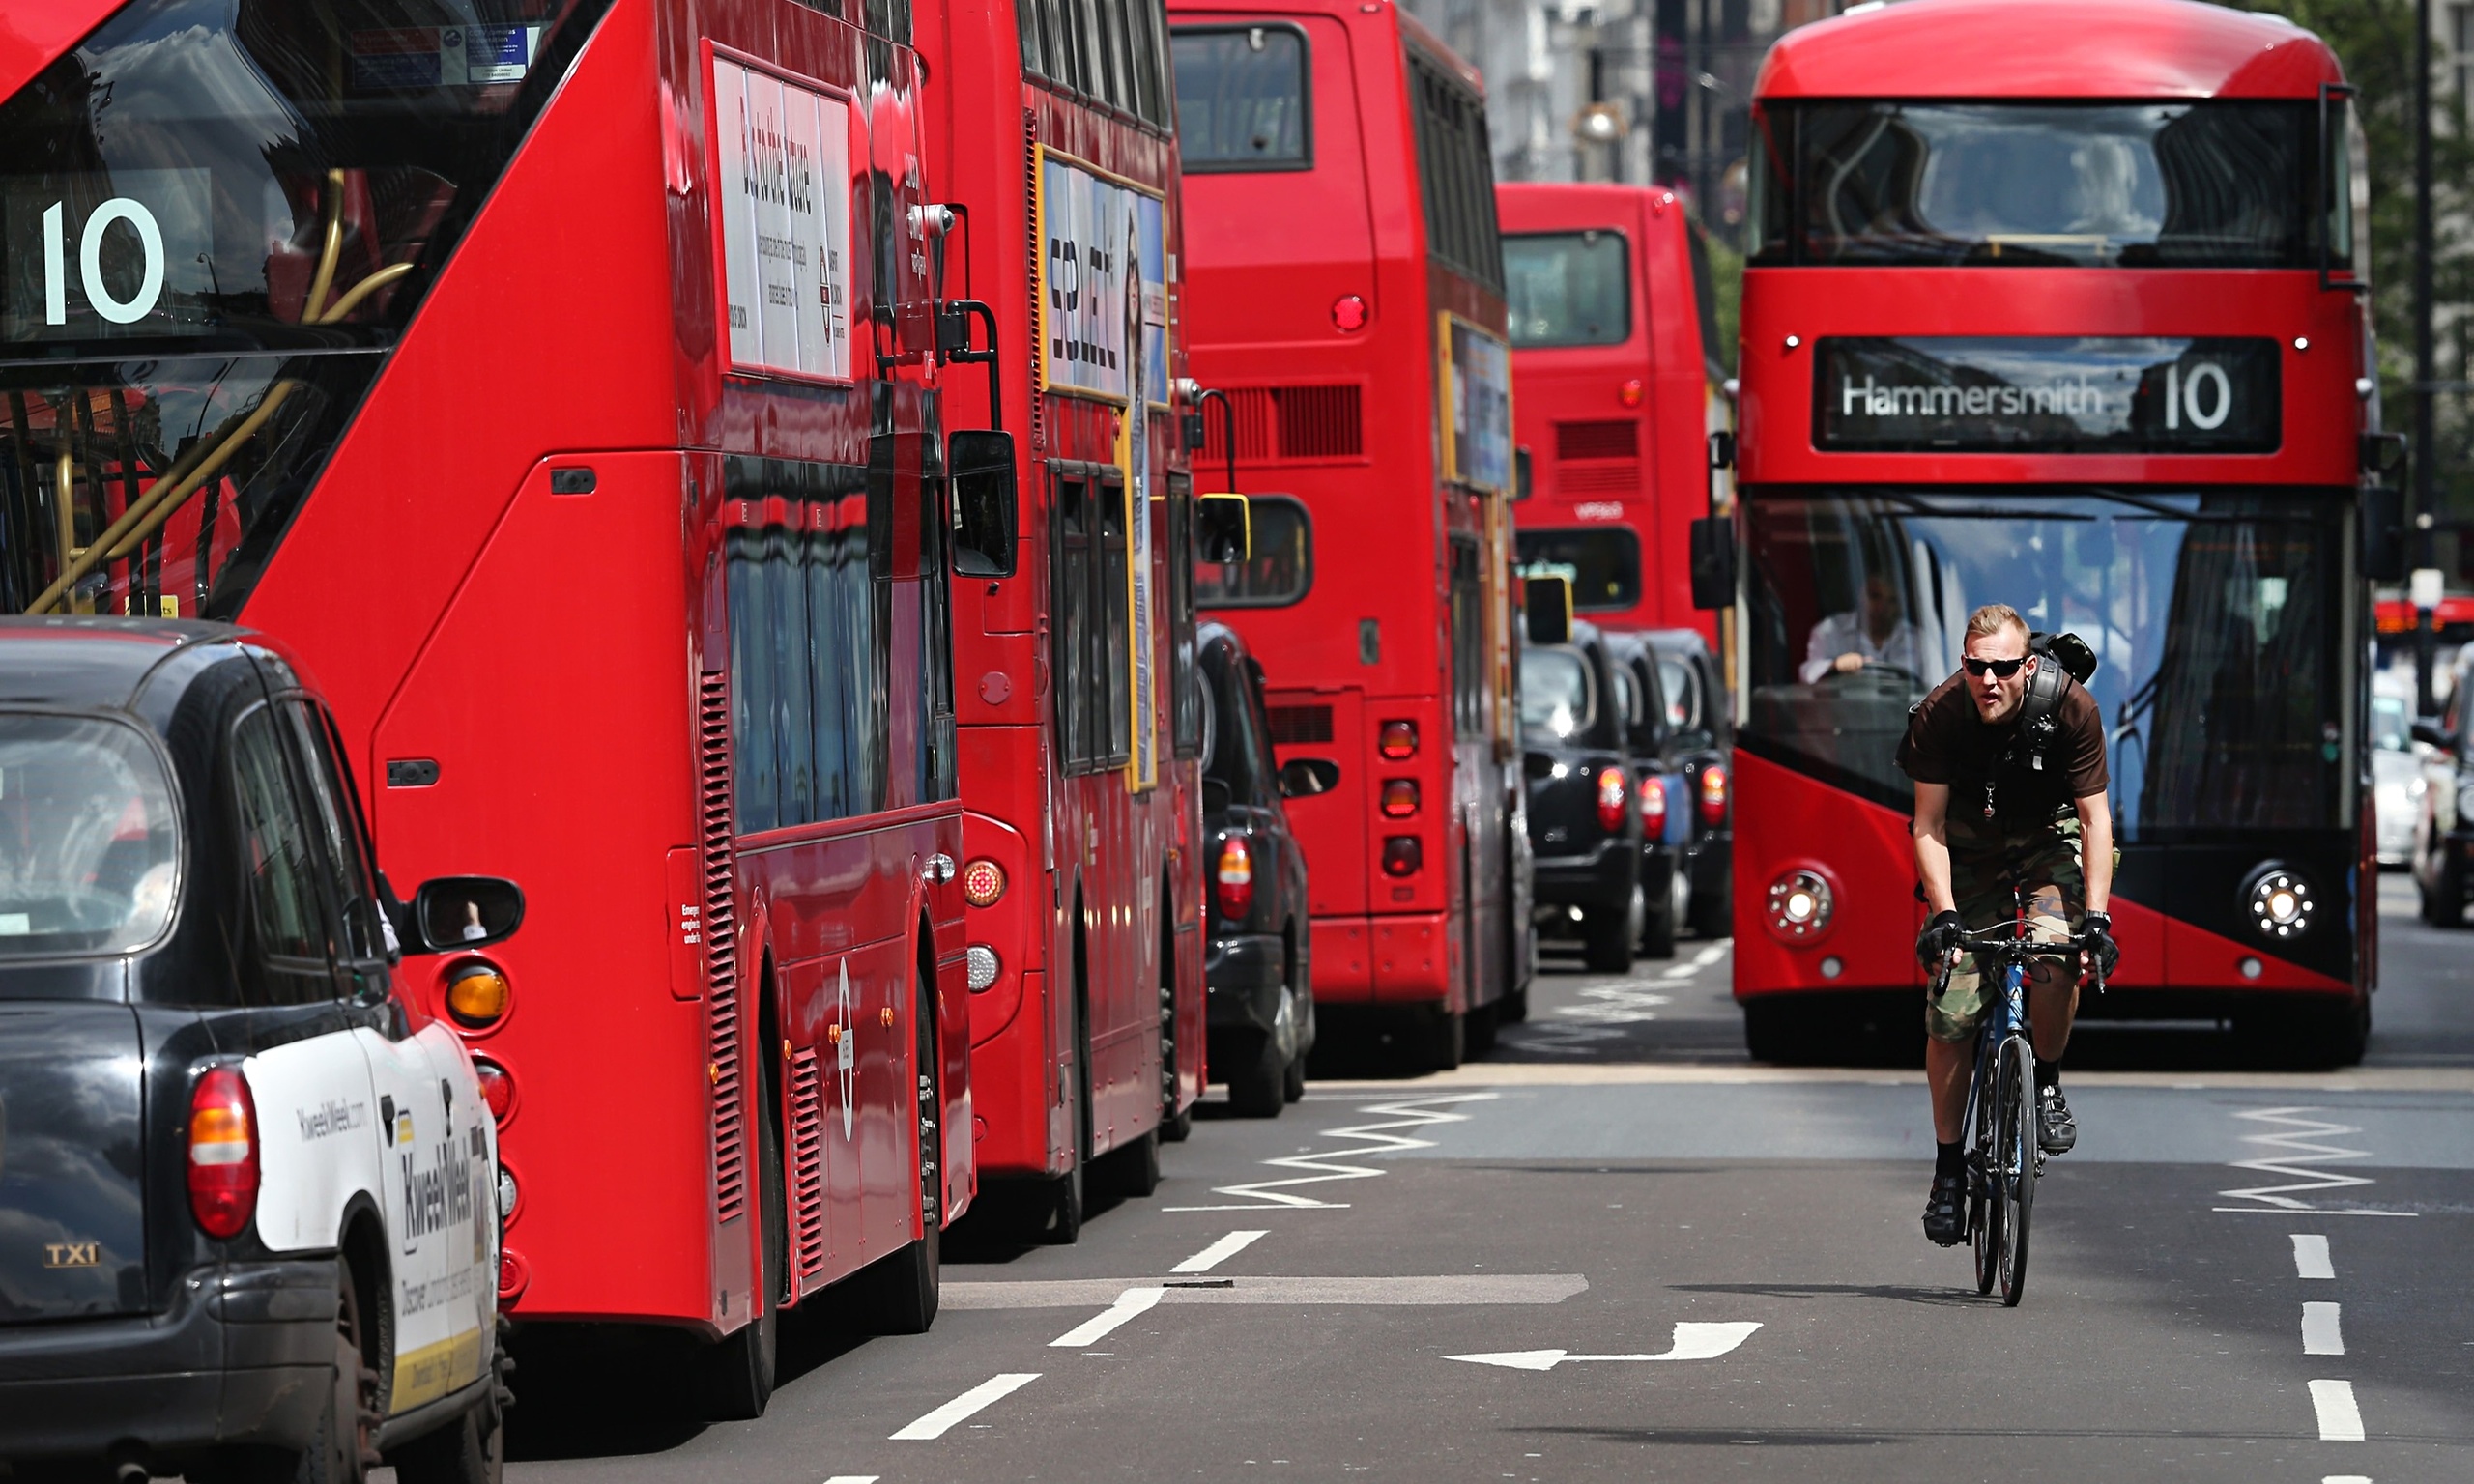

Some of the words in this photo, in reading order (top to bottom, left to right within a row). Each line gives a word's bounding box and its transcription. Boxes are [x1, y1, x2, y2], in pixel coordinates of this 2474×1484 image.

[767, 105, 785, 207] the
[43, 198, 165, 326] 10
[1843, 374, 2104, 415] Hammersmith
[2165, 361, 2231, 431] 10
